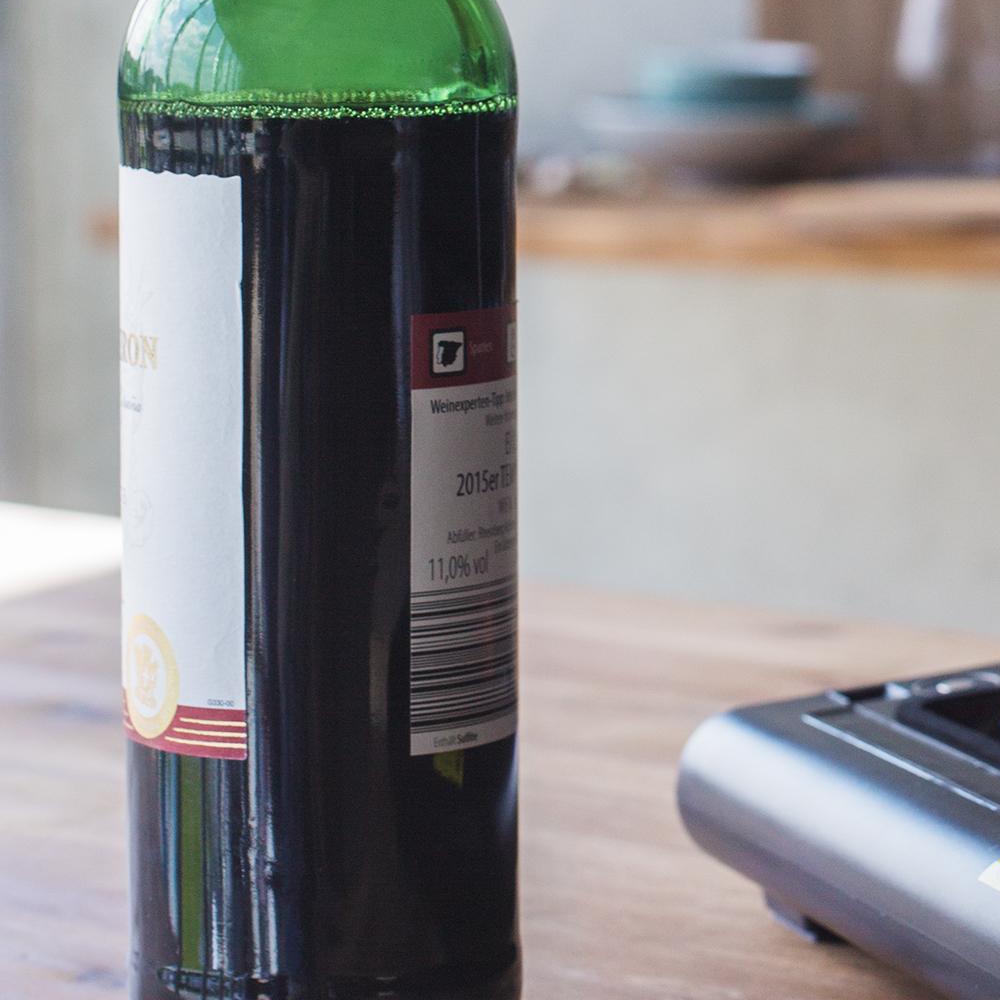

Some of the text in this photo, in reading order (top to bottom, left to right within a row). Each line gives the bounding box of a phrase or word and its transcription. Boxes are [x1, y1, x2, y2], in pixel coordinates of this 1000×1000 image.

[456, 469, 500, 497] 2015er
[428, 548, 488, 584] 11,0% vol
